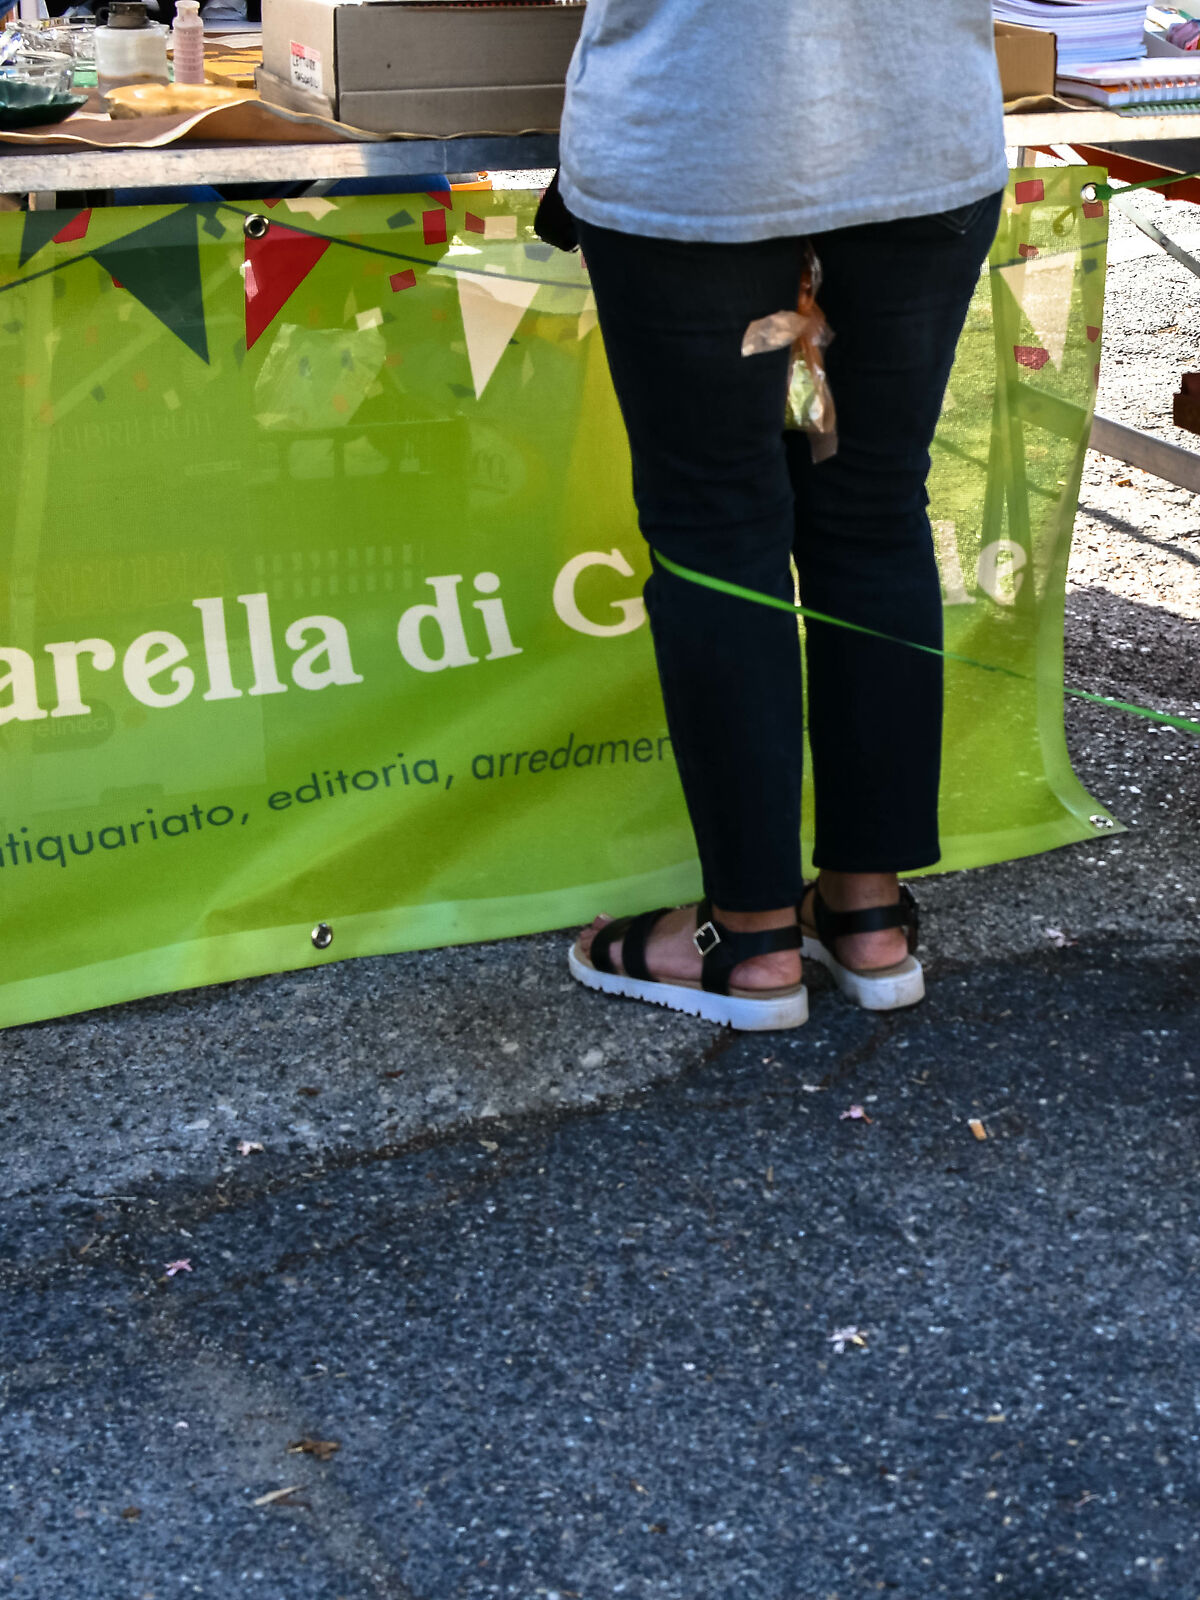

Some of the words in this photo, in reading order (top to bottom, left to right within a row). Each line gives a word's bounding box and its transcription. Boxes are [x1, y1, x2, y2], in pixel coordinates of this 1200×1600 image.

[396, 571, 523, 673] di
[0, 803, 250, 869] tiquariato,
[266, 751, 455, 812] editoria,
